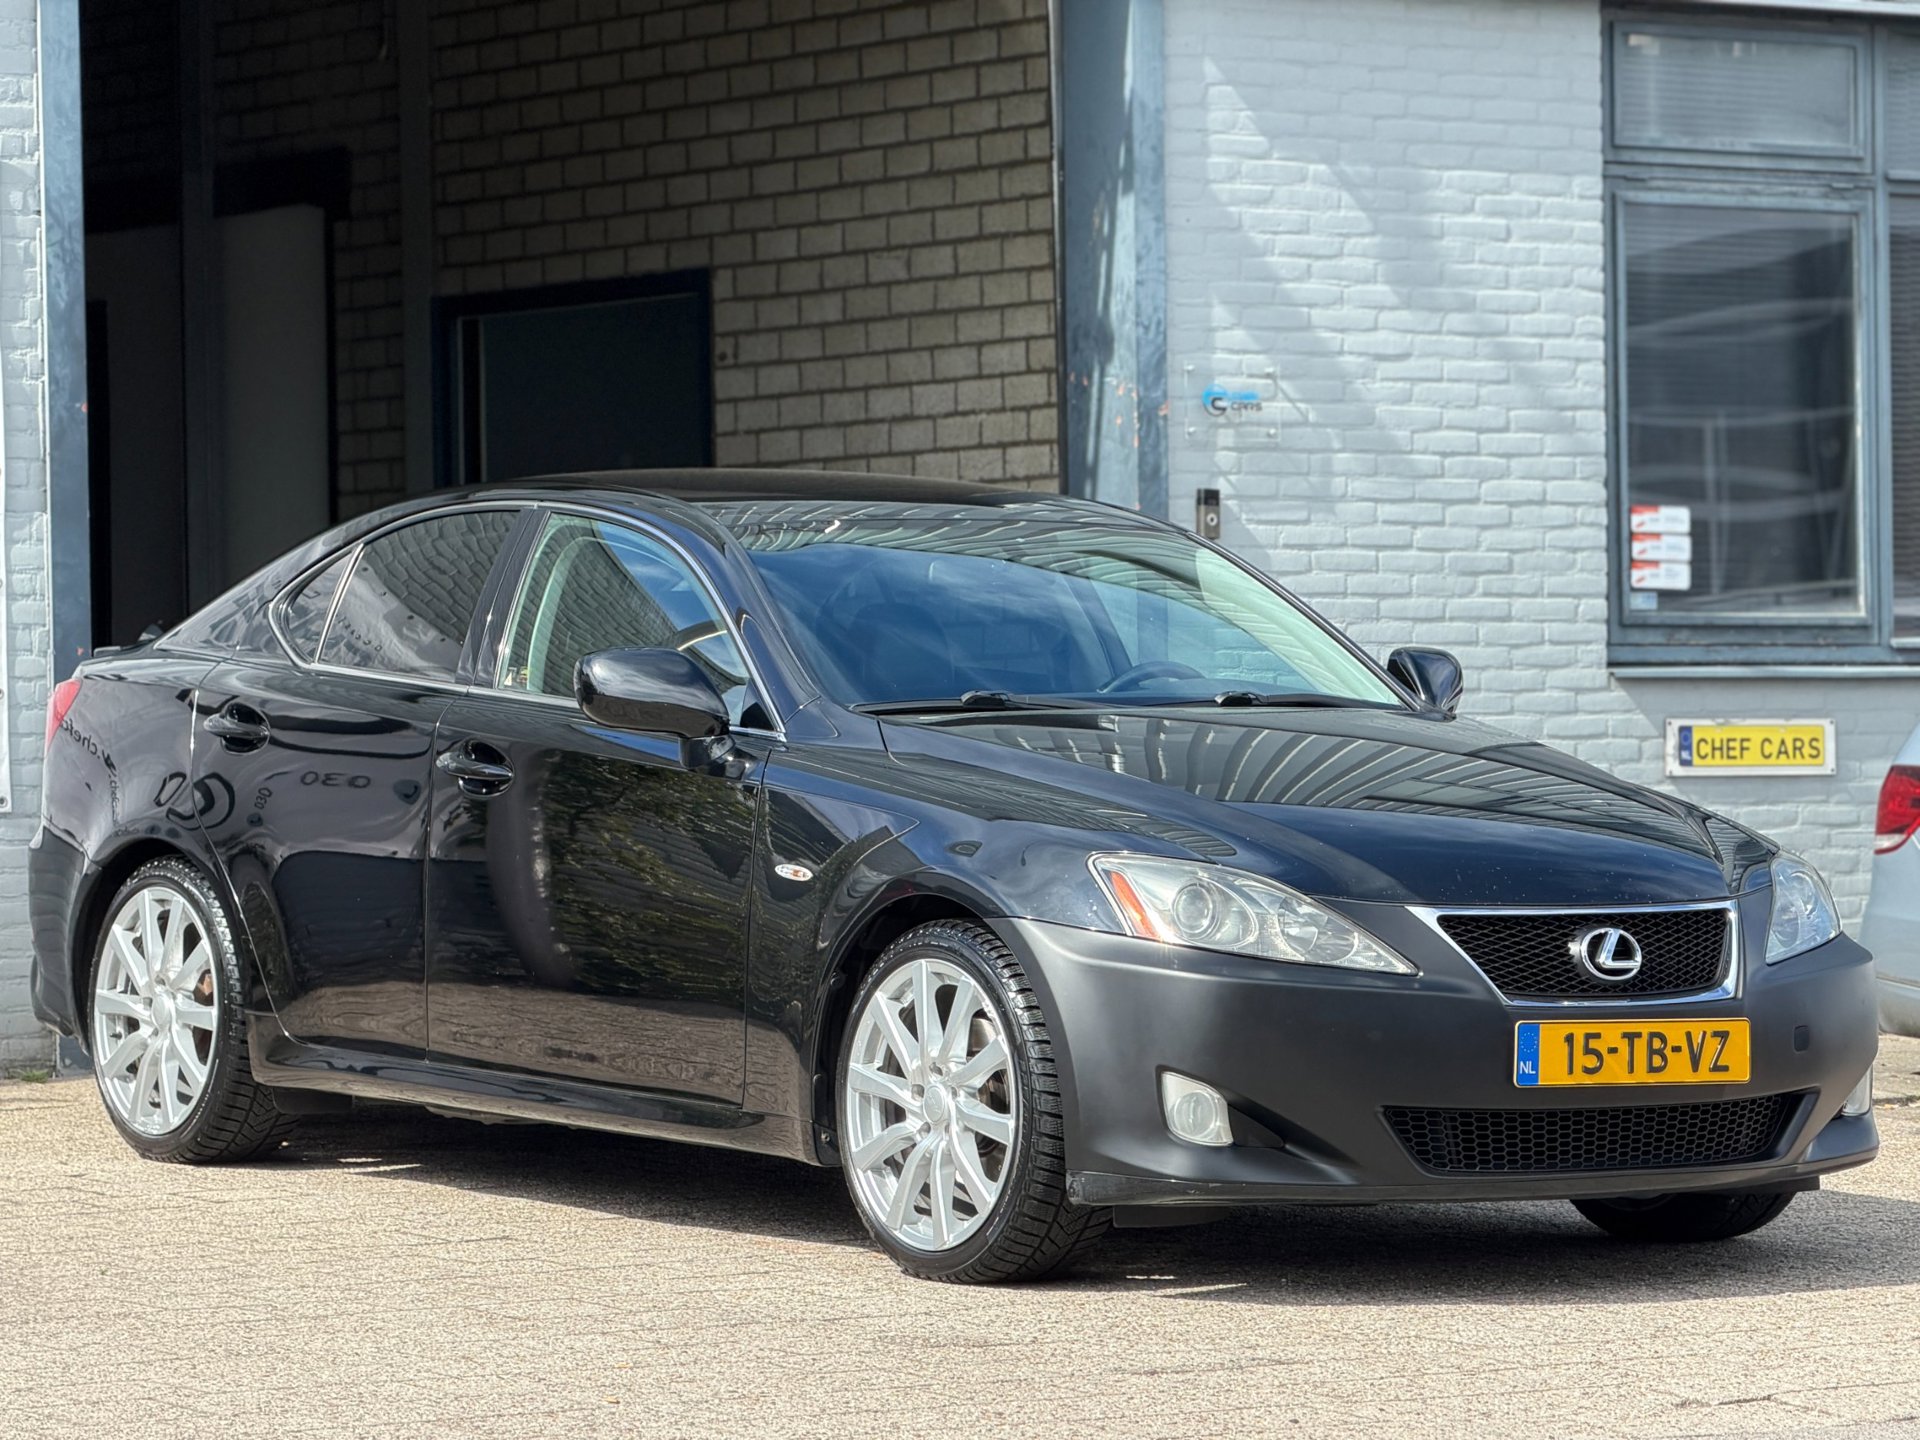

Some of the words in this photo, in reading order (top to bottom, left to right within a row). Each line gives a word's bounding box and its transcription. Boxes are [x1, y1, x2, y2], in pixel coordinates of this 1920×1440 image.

[1695, 738, 1751, 760] CHEF
[1760, 737, 1821, 760] CARS
[1563, 1030, 1731, 1075] 15-TB-VZ
[1519, 1060, 1536, 1075] NL
